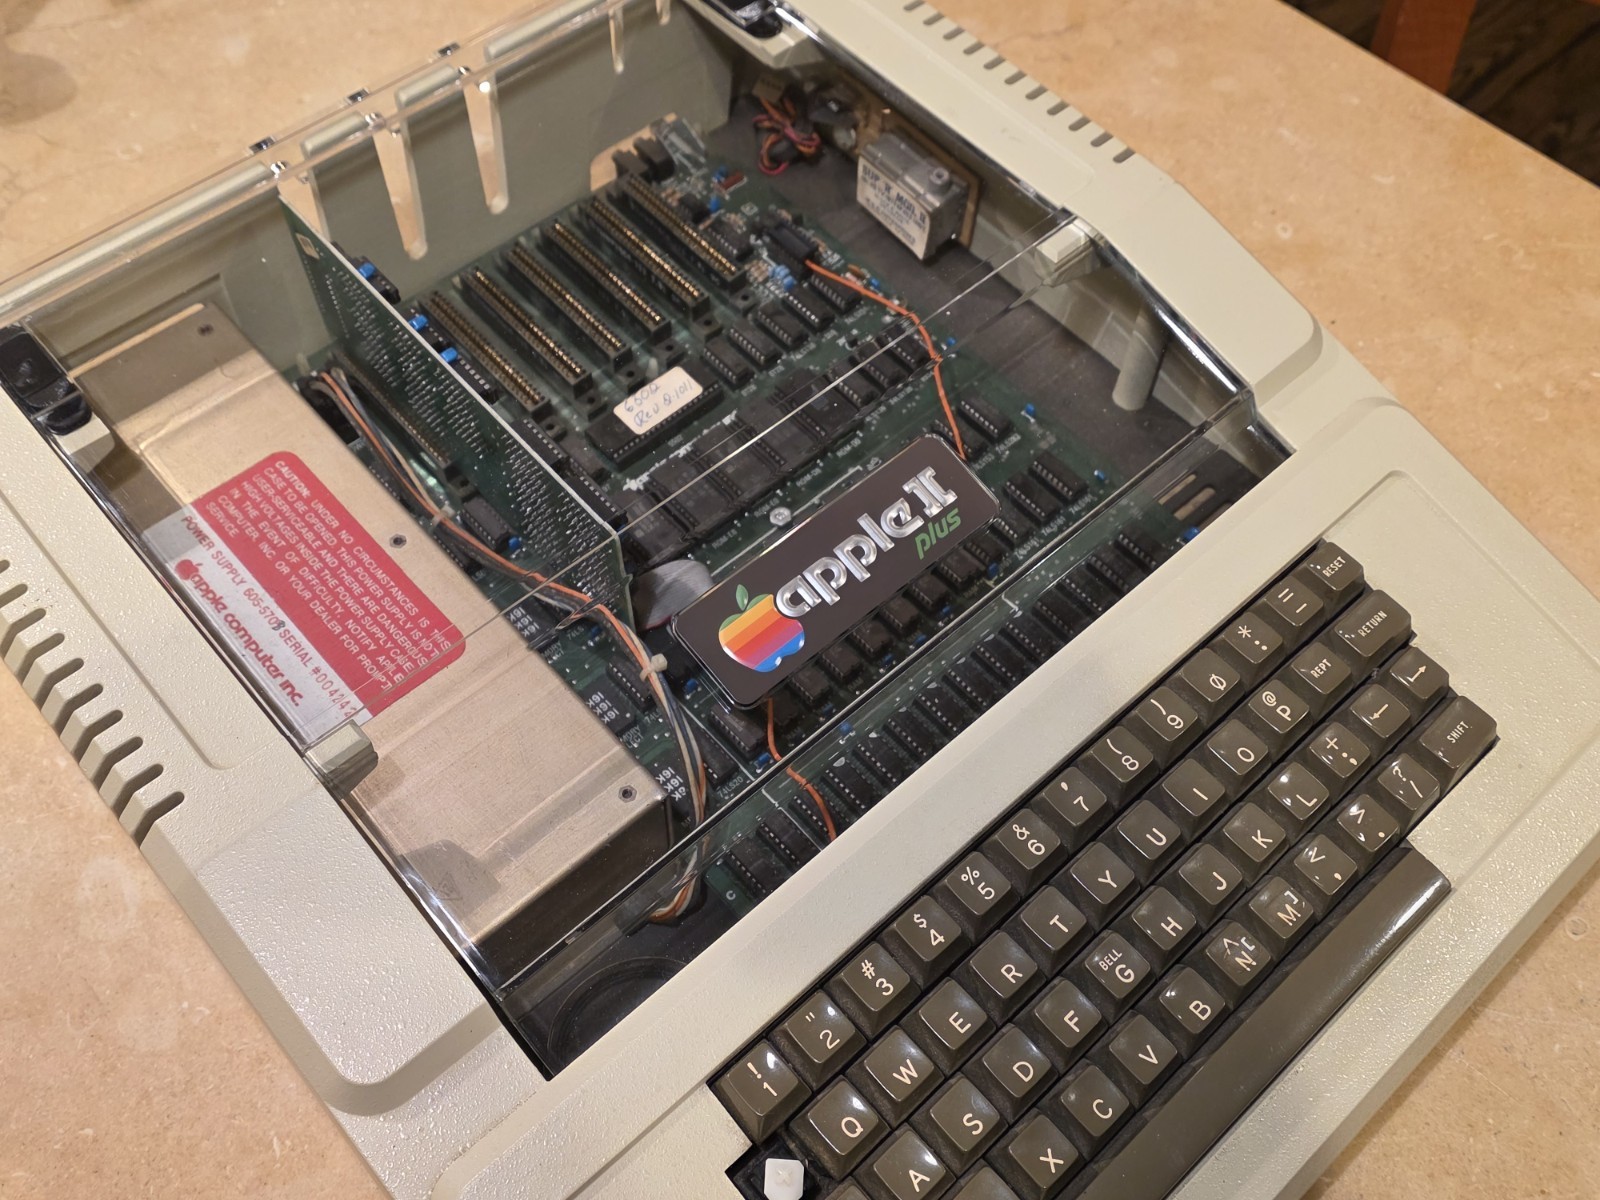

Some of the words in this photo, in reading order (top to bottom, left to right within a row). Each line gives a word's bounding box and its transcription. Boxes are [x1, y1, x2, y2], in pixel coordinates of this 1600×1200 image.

[252, 473, 323, 550] USER-SERVICEABLE
[317, 549, 339, 568] AND
[336, 566, 365, 597] THERE
[360, 595, 381, 615] ARE
[914, 508, 962, 560] plus
[241, 480, 263, 503] HIGH
[259, 500, 300, 545] VOLTAGES
[295, 541, 324, 571] INSIDE
[319, 568, 340, 589] THE
[333, 585, 365, 619] POWER
[360, 615, 395, 649] SUPPLY
[263, 467, 287, 491] CASE
[283, 487, 299, 503] TO
[293, 500, 309, 515] BE
[336, 546, 357, 569] THIS
[353, 566, 385, 599] POWER
[380, 596, 414, 629] SUPPLY
[409, 628, 423, 641] IS
[310, 499, 340, 529] UNDER
[337, 529, 355, 545] NO
[352, 545, 419, 617] CIRCUMSTANCES
[417, 616, 431, 629] IS
[776, 498, 925, 618] apple
[229, 487, 243, 500] IN
[241, 500, 261, 519] THE
[257, 520, 287, 548] EVENT
[284, 551, 301, 564] OF
[344, 618, 378, 651] NOTIFY
[1322, 556, 1346, 577] RESET
[180, 515, 215, 549] POWER
[211, 549, 248, 587] SUPPLY
[278, 628, 313, 668] SERIAL
[274, 560, 291, 575] OR
[288, 574, 313, 601] YOUR
[309, 599, 343, 635] DEALER
[339, 633, 360, 655] FOR
[1358, 610, 1387, 637] RETURN
[190, 570, 226, 615] apple
[223, 612, 284, 681] computer
[279, 678, 304, 708] inc.
[1310, 658, 1331, 678] REPT
[1167, 714, 1184, 729] 9
[1276, 705, 1291, 721] P
[1447, 721, 1469, 743] SHIFT
[1121, 755, 1139, 771] 8
[1237, 747, 1255, 762] O
[1073, 796, 1089, 811] 7
[1193, 788, 1208, 800] I
[1296, 794, 1318, 807] L
[1028, 839, 1045, 855] 6
[1146, 828, 1167, 846] U
[1251, 829, 1273, 849] K
[1098, 870, 1117, 888] Y
[1212, 871, 1227, 890] J
[977, 882, 995, 900] 5
[1049, 914, 1068, 933] T
[1277, 903, 1301, 926] M
[1161, 916, 1183, 937] H
[930, 929, 945, 946] 4
[1098, 949, 1123, 971] BELL
[1235, 950, 1257, 971] N
[1001, 964, 1023, 983] R
[1115, 964, 1134, 983] G
[876, 978, 894, 996] 3
[1189, 1000, 1211, 1020] B
[949, 1011, 971, 1034] E
[1064, 1010, 1080, 1032] F
[819, 1029, 840, 1049] 2
[1138, 1045, 1158, 1064] V
[892, 1059, 918, 1084] W
[1012, 1061, 1034, 1082] D
[763, 1082, 777, 1096] 1
[1093, 1099, 1112, 1119] C
[841, 1117, 864, 1138] Q
[963, 1113, 983, 1135] S
[1039, 1148, 1064, 1173] X
[909, 1169, 930, 1192] A
